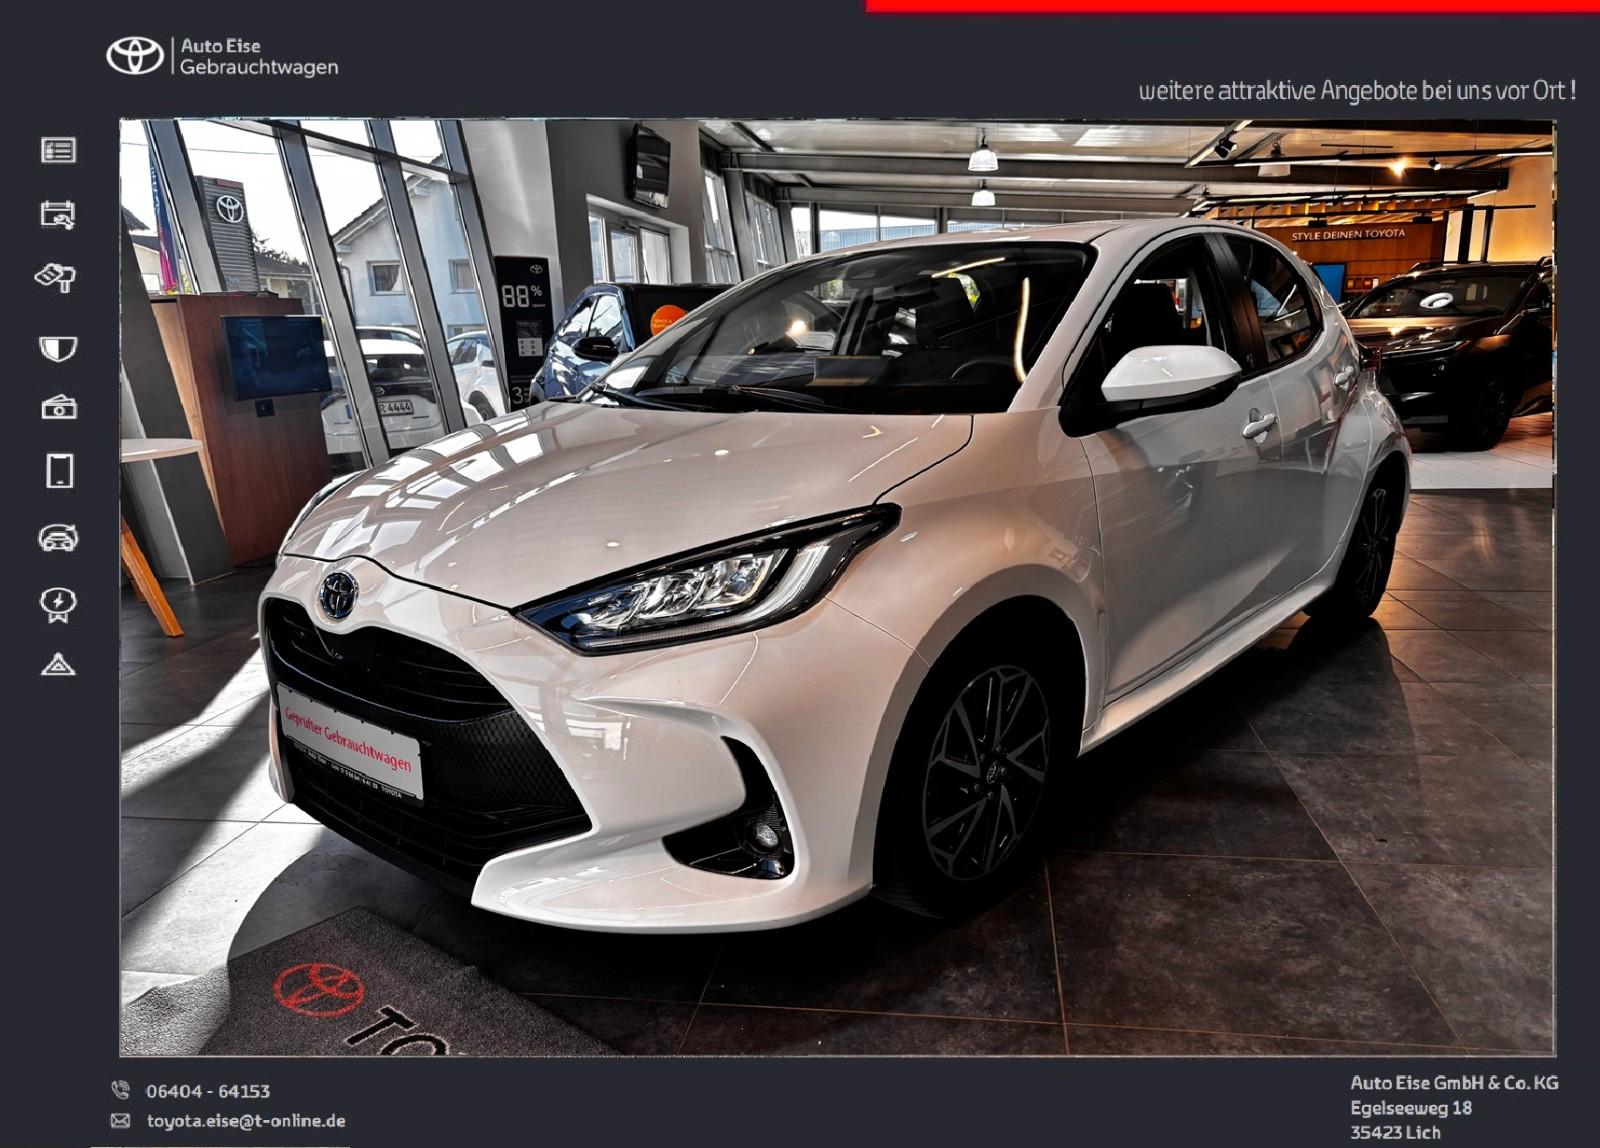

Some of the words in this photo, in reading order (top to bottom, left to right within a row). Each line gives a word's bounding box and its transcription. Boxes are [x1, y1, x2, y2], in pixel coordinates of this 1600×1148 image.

[1292, 231, 1321, 242] STYLE
[1323, 230, 1363, 241] DEINEN
[1365, 229, 1406, 239] TOYOTA
[323, 727, 412, 773] Gebrauchtwagen
